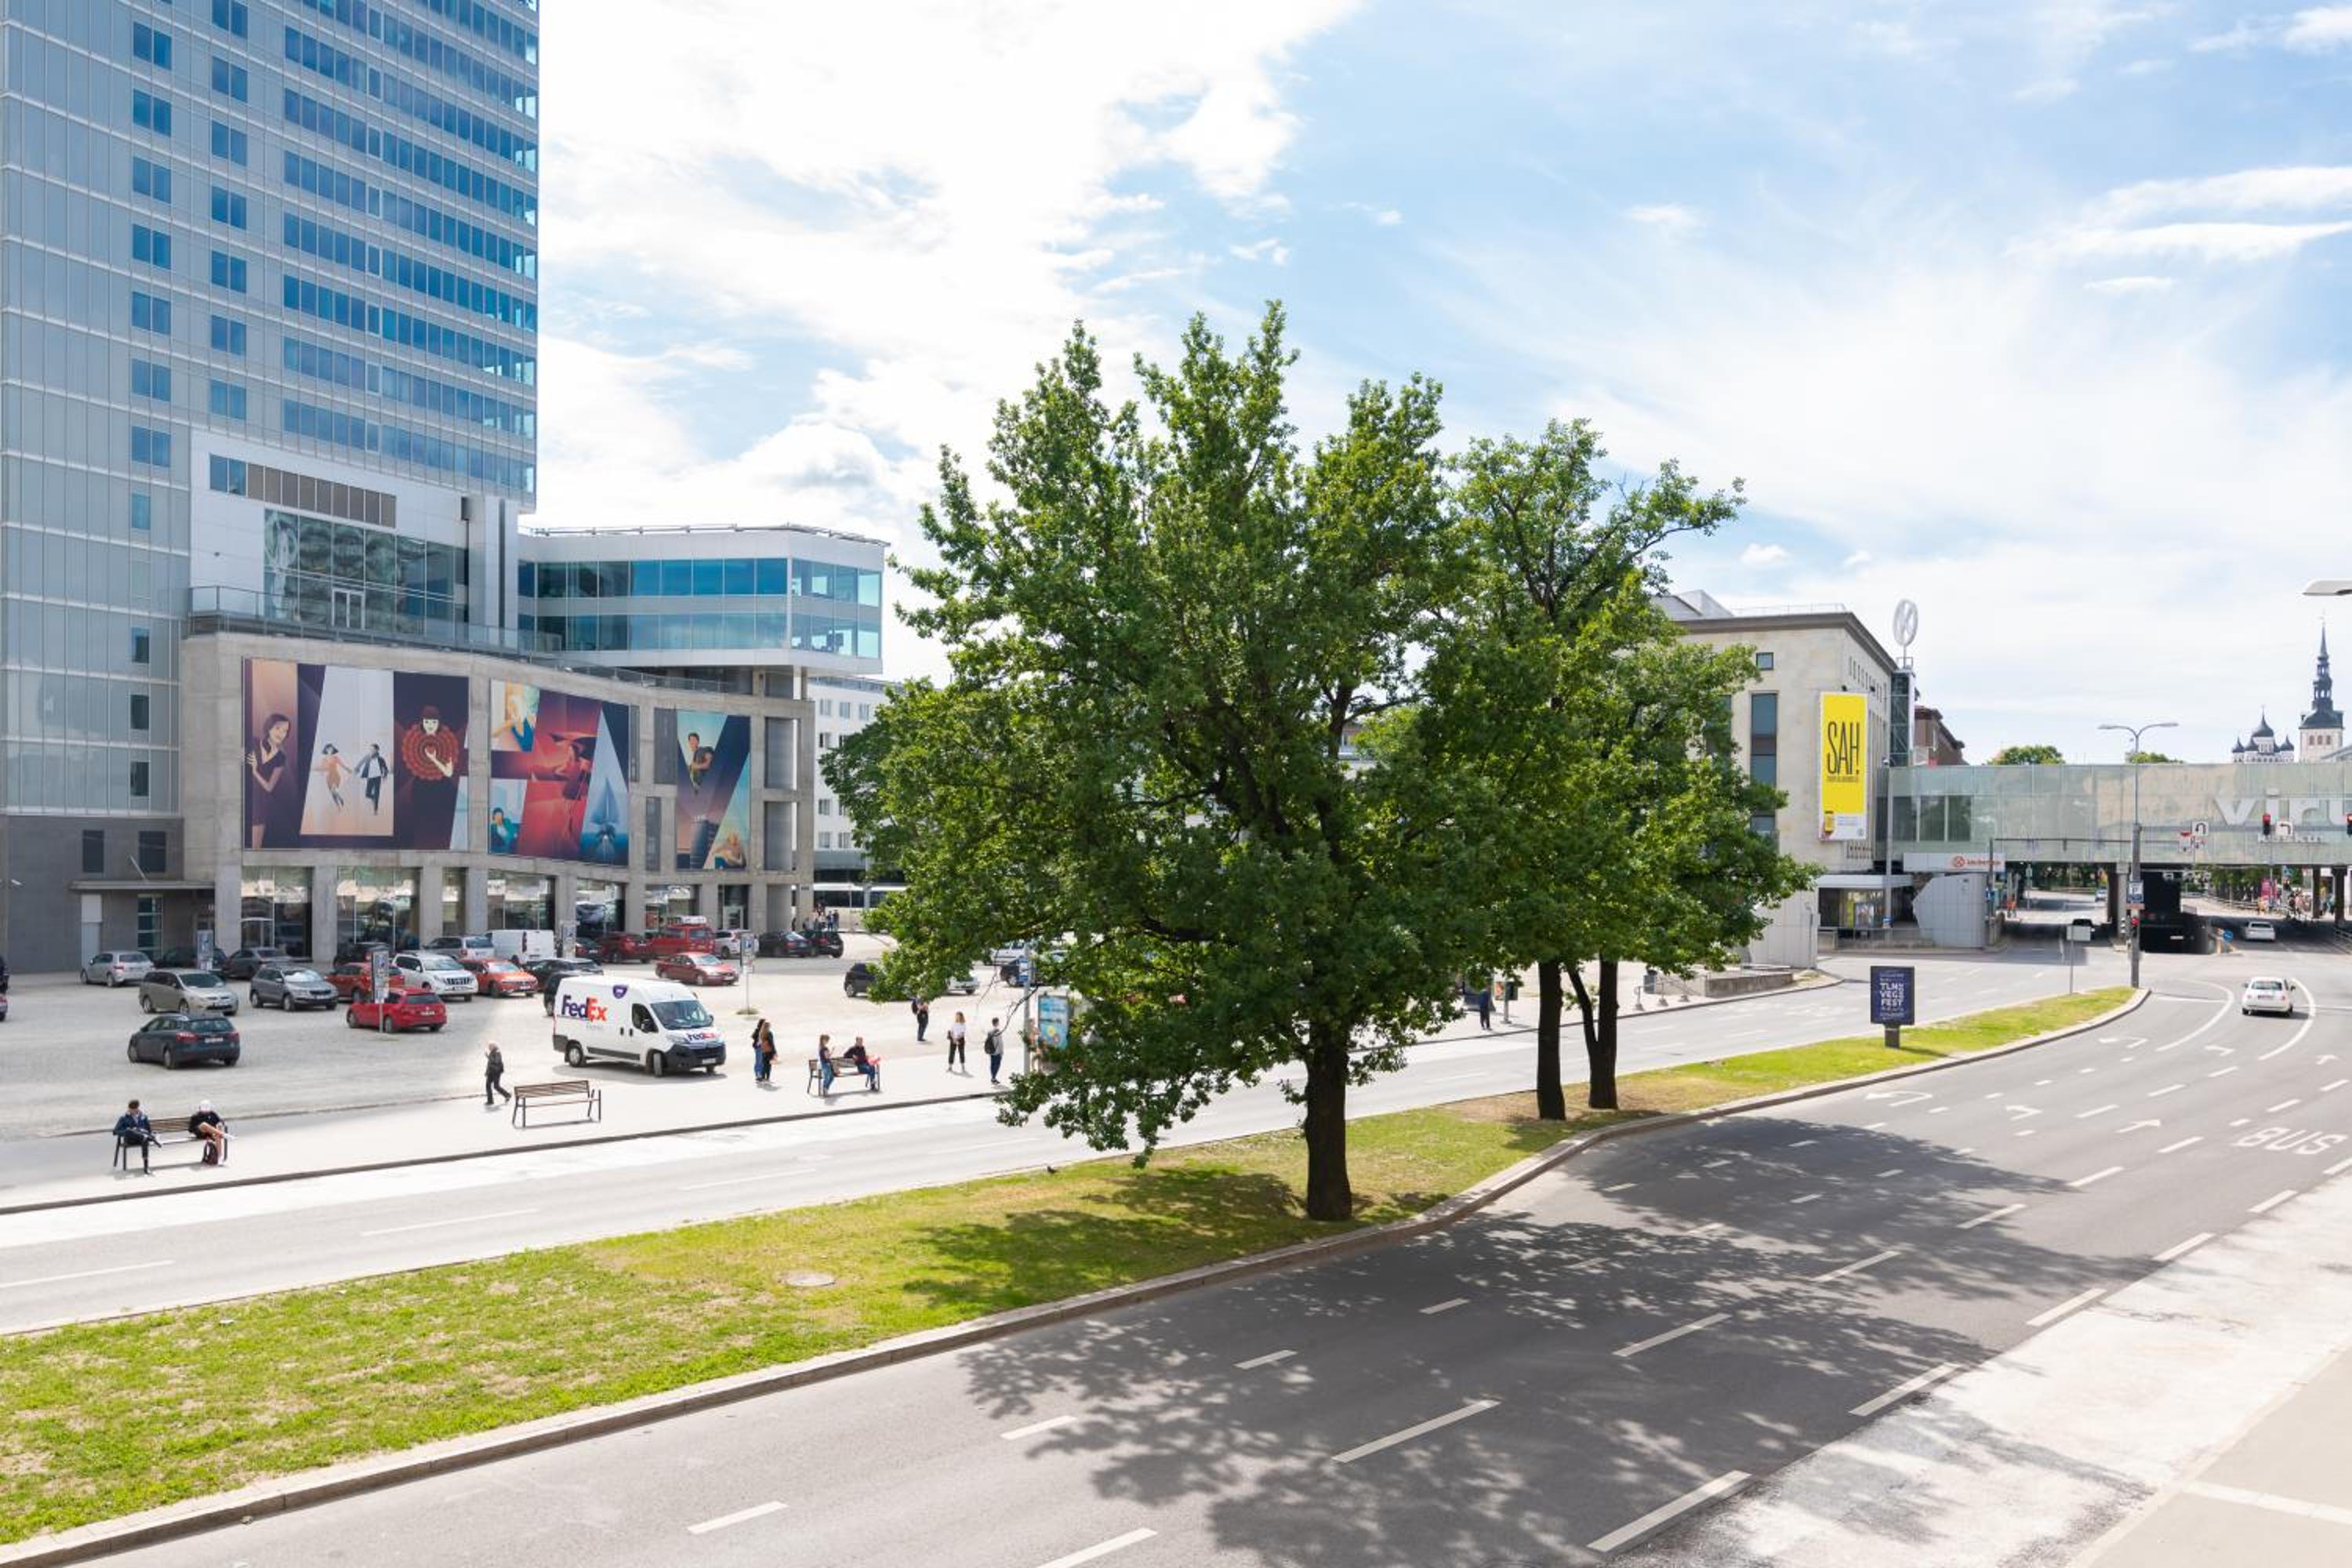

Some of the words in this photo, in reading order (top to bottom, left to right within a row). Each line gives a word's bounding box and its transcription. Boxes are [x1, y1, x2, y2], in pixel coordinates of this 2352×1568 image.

[1827, 720, 1860, 775] SAH!
[561, 995, 607, 1022] FedEx
[2230, 1127, 2348, 1155] BUS
